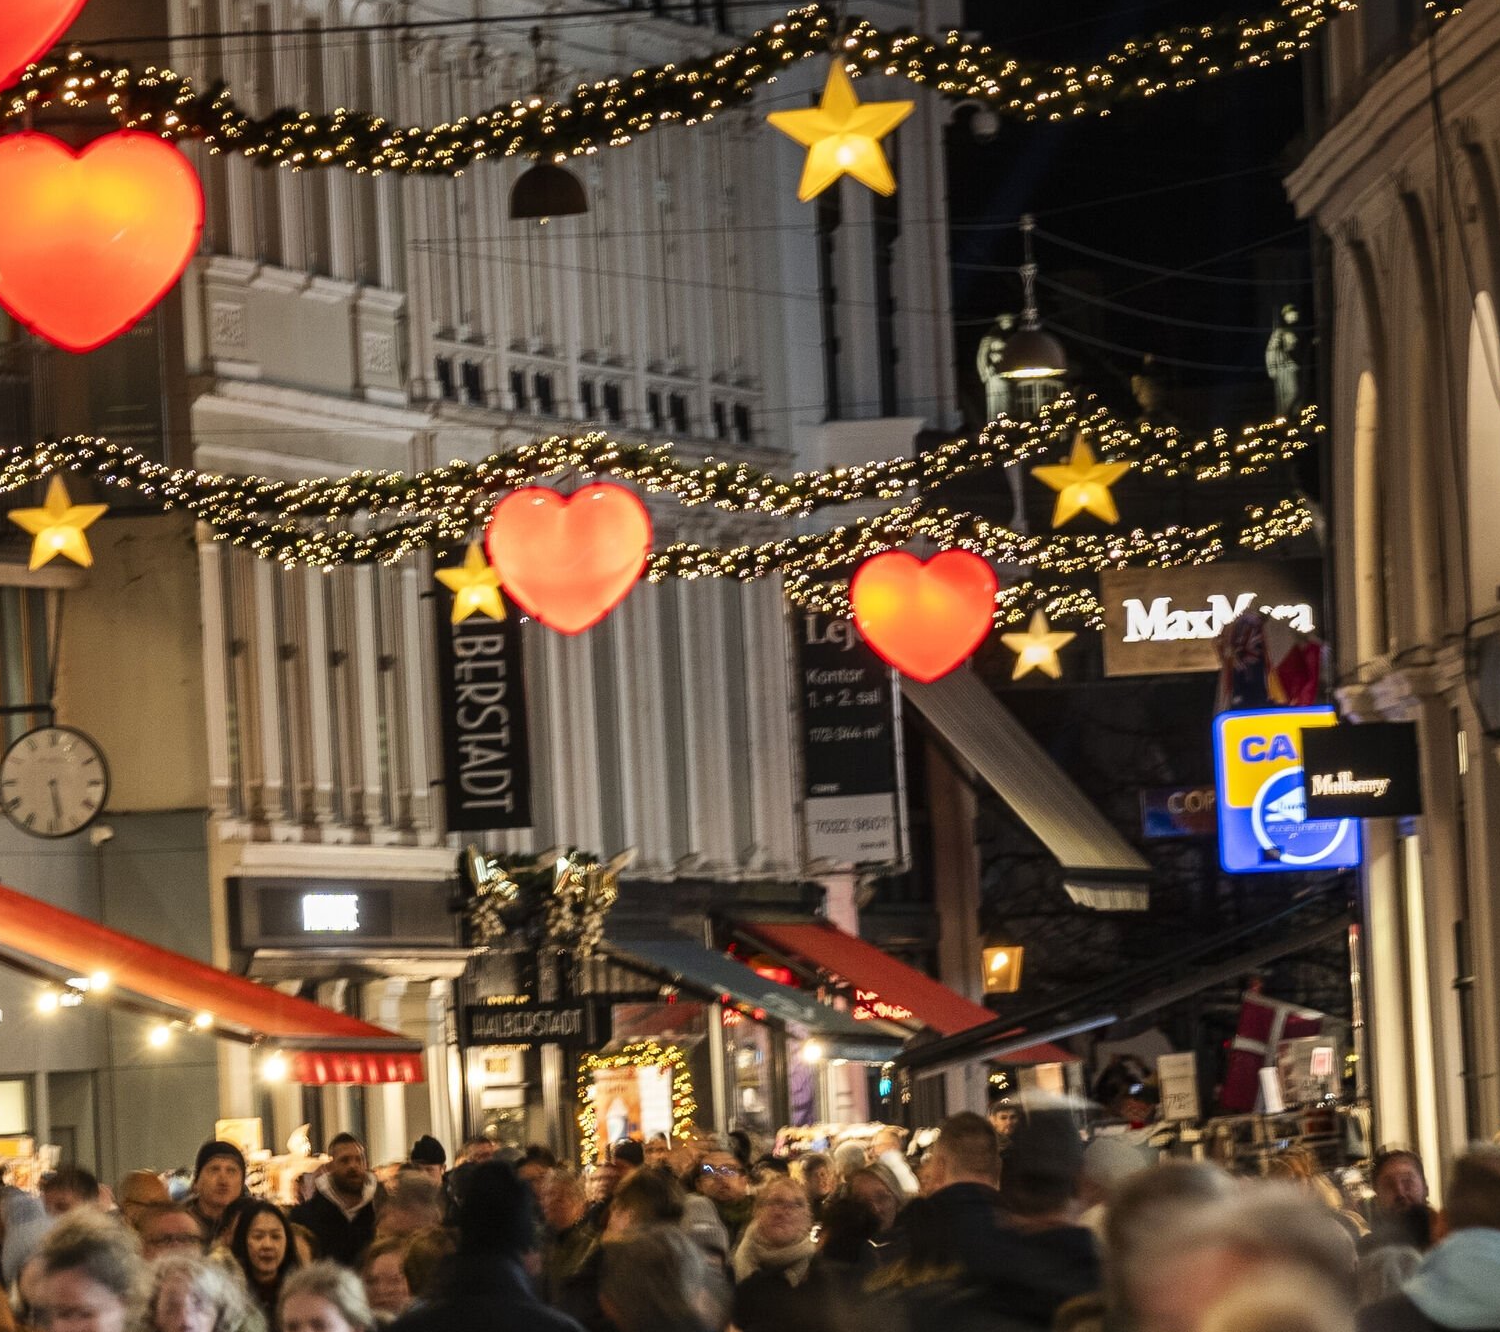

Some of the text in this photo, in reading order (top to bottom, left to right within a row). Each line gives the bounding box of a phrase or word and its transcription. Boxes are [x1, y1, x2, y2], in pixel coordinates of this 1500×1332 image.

[452, 617, 514, 814] LBERSTADT
[1240, 734, 1297, 763] CA
[1311, 771, 1392, 798] Mulberry
